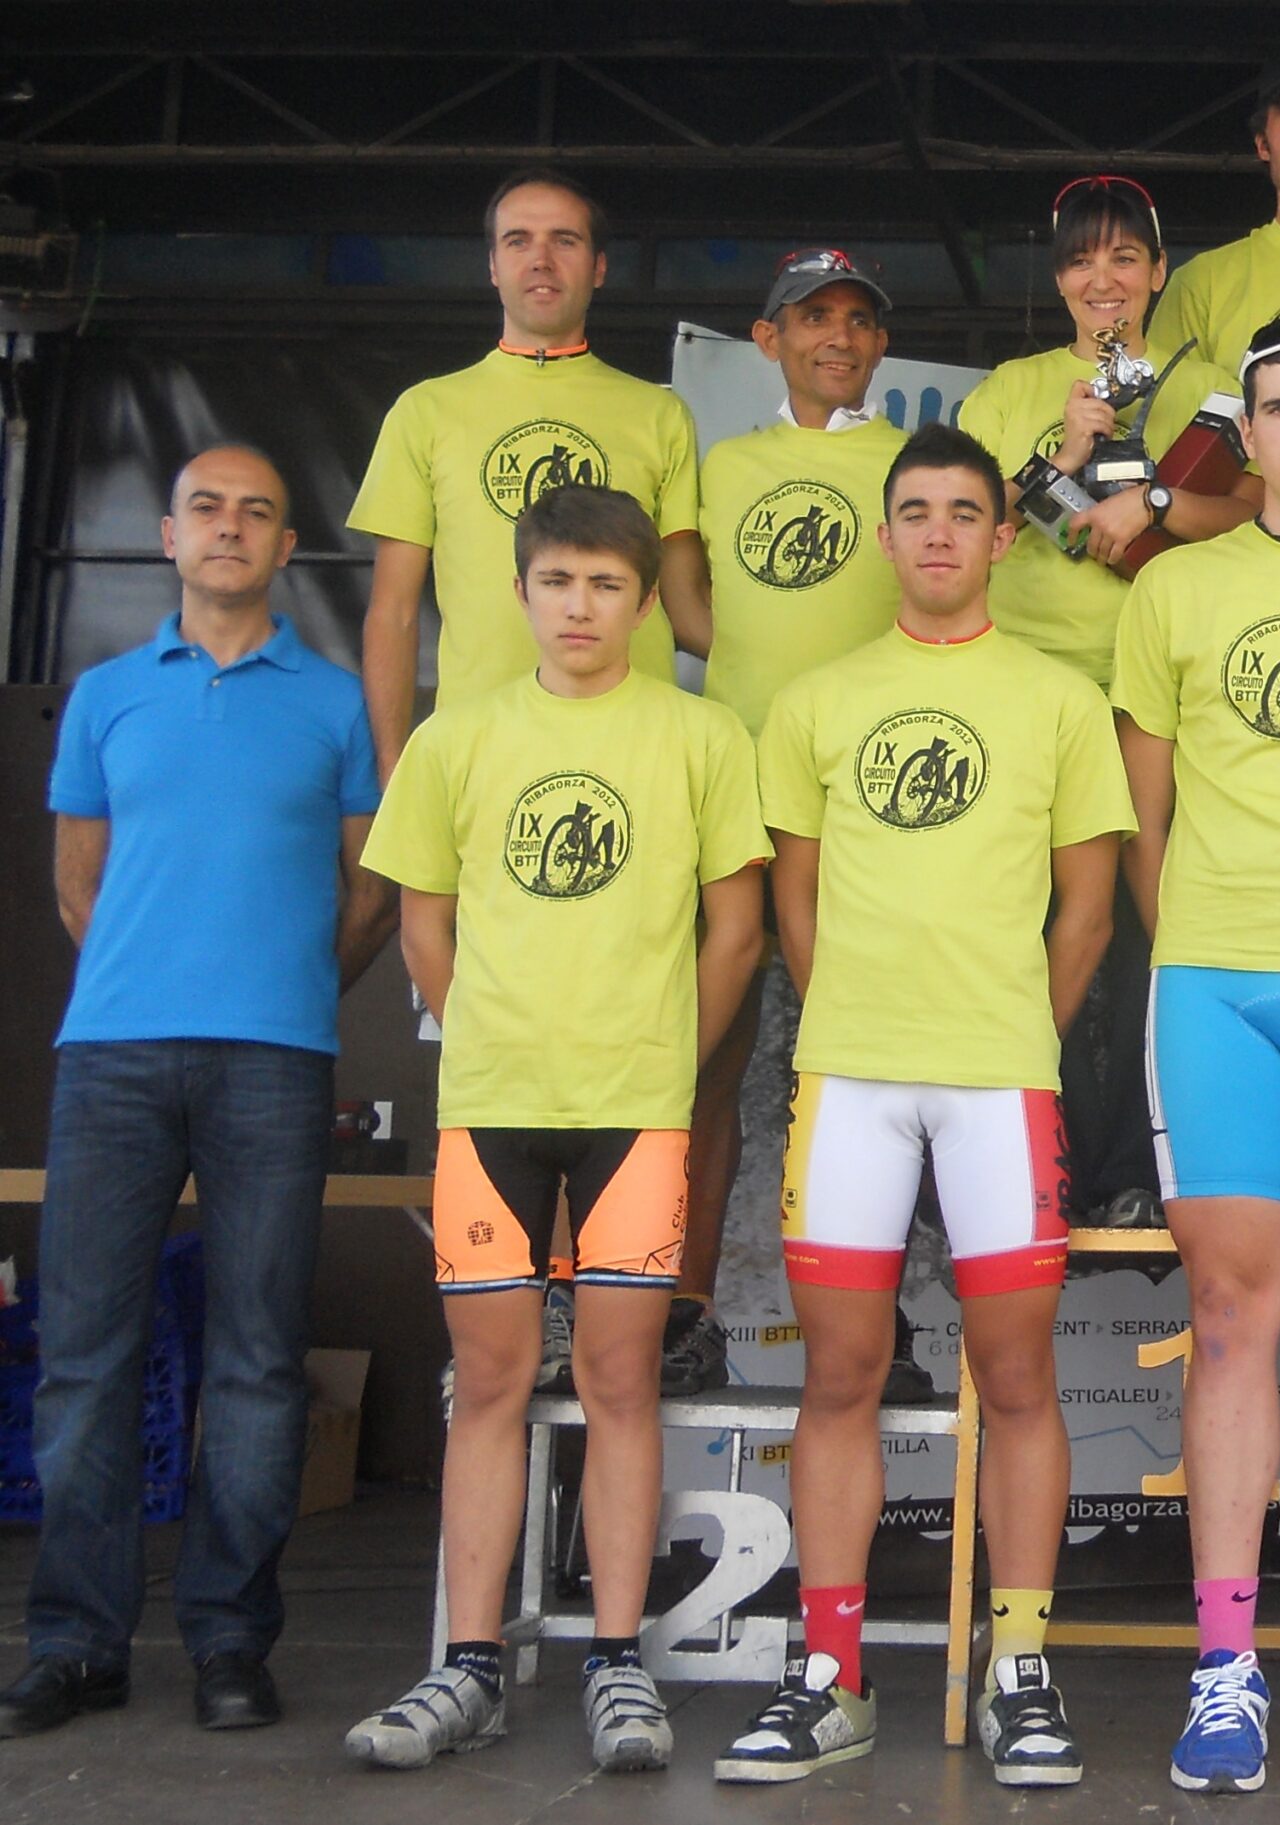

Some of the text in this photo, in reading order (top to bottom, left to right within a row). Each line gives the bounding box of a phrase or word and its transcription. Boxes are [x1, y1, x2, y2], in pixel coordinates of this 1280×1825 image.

[502, 425, 591, 450] RIBAGORZA 2012
[499, 453, 521, 474] IX
[497, 488, 522, 500] BTT
[764, 485, 846, 511] RIBAGORZA 2012
[753, 510, 778, 532] IX
[744, 543, 768, 555] BTT
[1240, 649, 1265, 676] IX
[1231, 675, 1264, 689] CIRCUITO
[1235, 690, 1261, 702] BTT
[880, 715, 973, 746] RIBAGORZA 2012
[874, 741, 898, 766] IX
[864, 767, 896, 781] CIRCUITO
[524, 779, 617, 809] RIBAGORZA 2012
[867, 782, 893, 794] BTT
[519, 812, 544, 838] IX
[509, 840, 542, 852] CIRCUITO
[514, 854, 540, 867] BTT
[763, 1445, 792, 1460] BT
[1070, 1499, 1191, 1521] ibagorza.
[640, 1489, 792, 1681] 2
